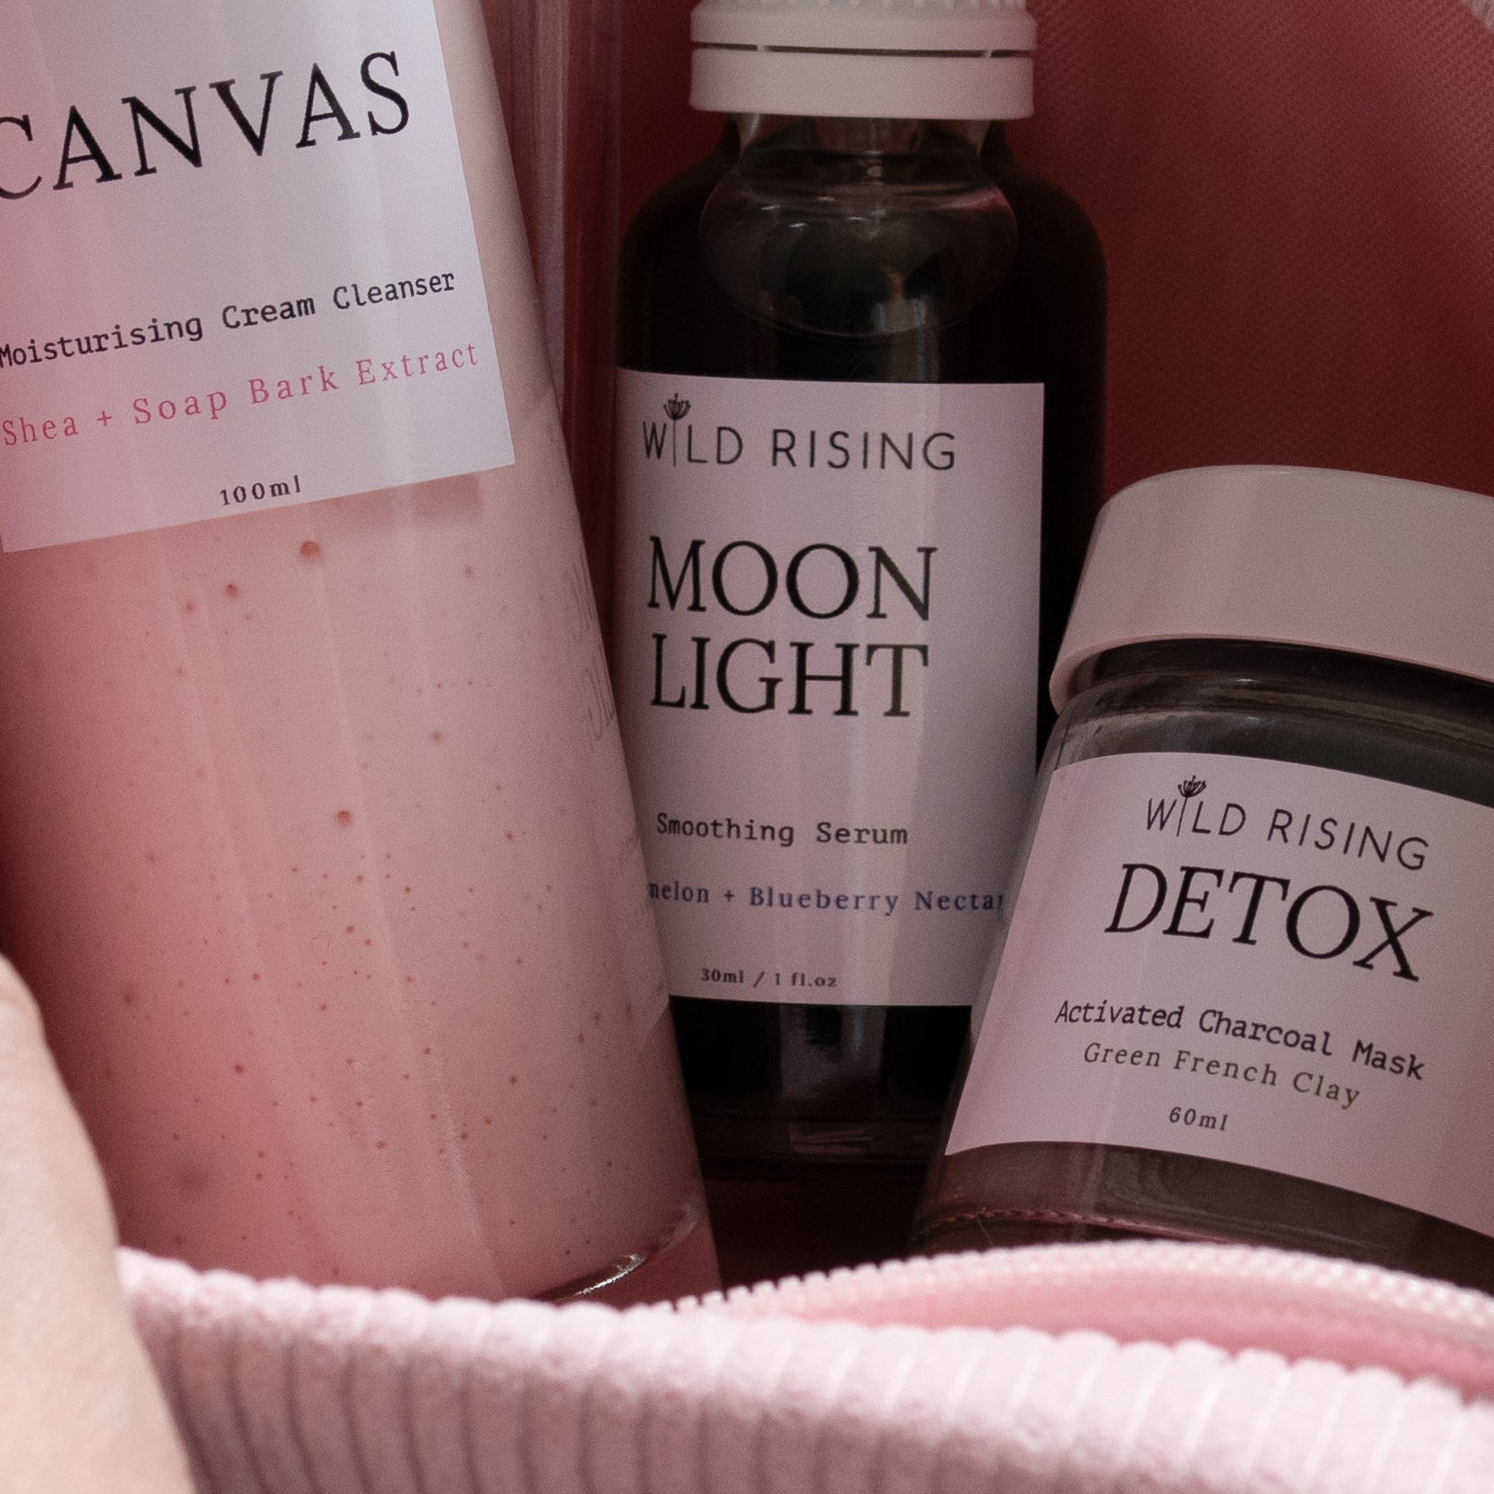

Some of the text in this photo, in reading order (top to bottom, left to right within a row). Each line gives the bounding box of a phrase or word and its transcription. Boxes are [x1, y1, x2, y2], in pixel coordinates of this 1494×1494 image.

[221, 296, 316, 330] Cream
[332, 271, 456, 311] Cleanser
[1, 416, 80, 447] Shea
[132, 389, 229, 426] Soap
[248, 365, 340, 406] Bark
[355, 343, 479, 387] Extract
[642, 393, 957, 472] WILD RISING
[219, 474, 303, 507] 100ml
[647, 535, 938, 621] MOON
[650, 633, 930, 718] LIGHT
[656, 811, 909, 848] Smoothing Serum
[1146, 775, 1431, 871] WILD RISING
[749, 885, 899, 917] Blueberry
[1104, 863, 1434, 982] DETOX
[701, 967, 745, 984] 30ml
[1054, 999, 1426, 1082] Activated Charcoal Mask
[1083, 1041, 1361, 1111] Green French Clay
[1168, 1105, 1229, 1133] 60ml
